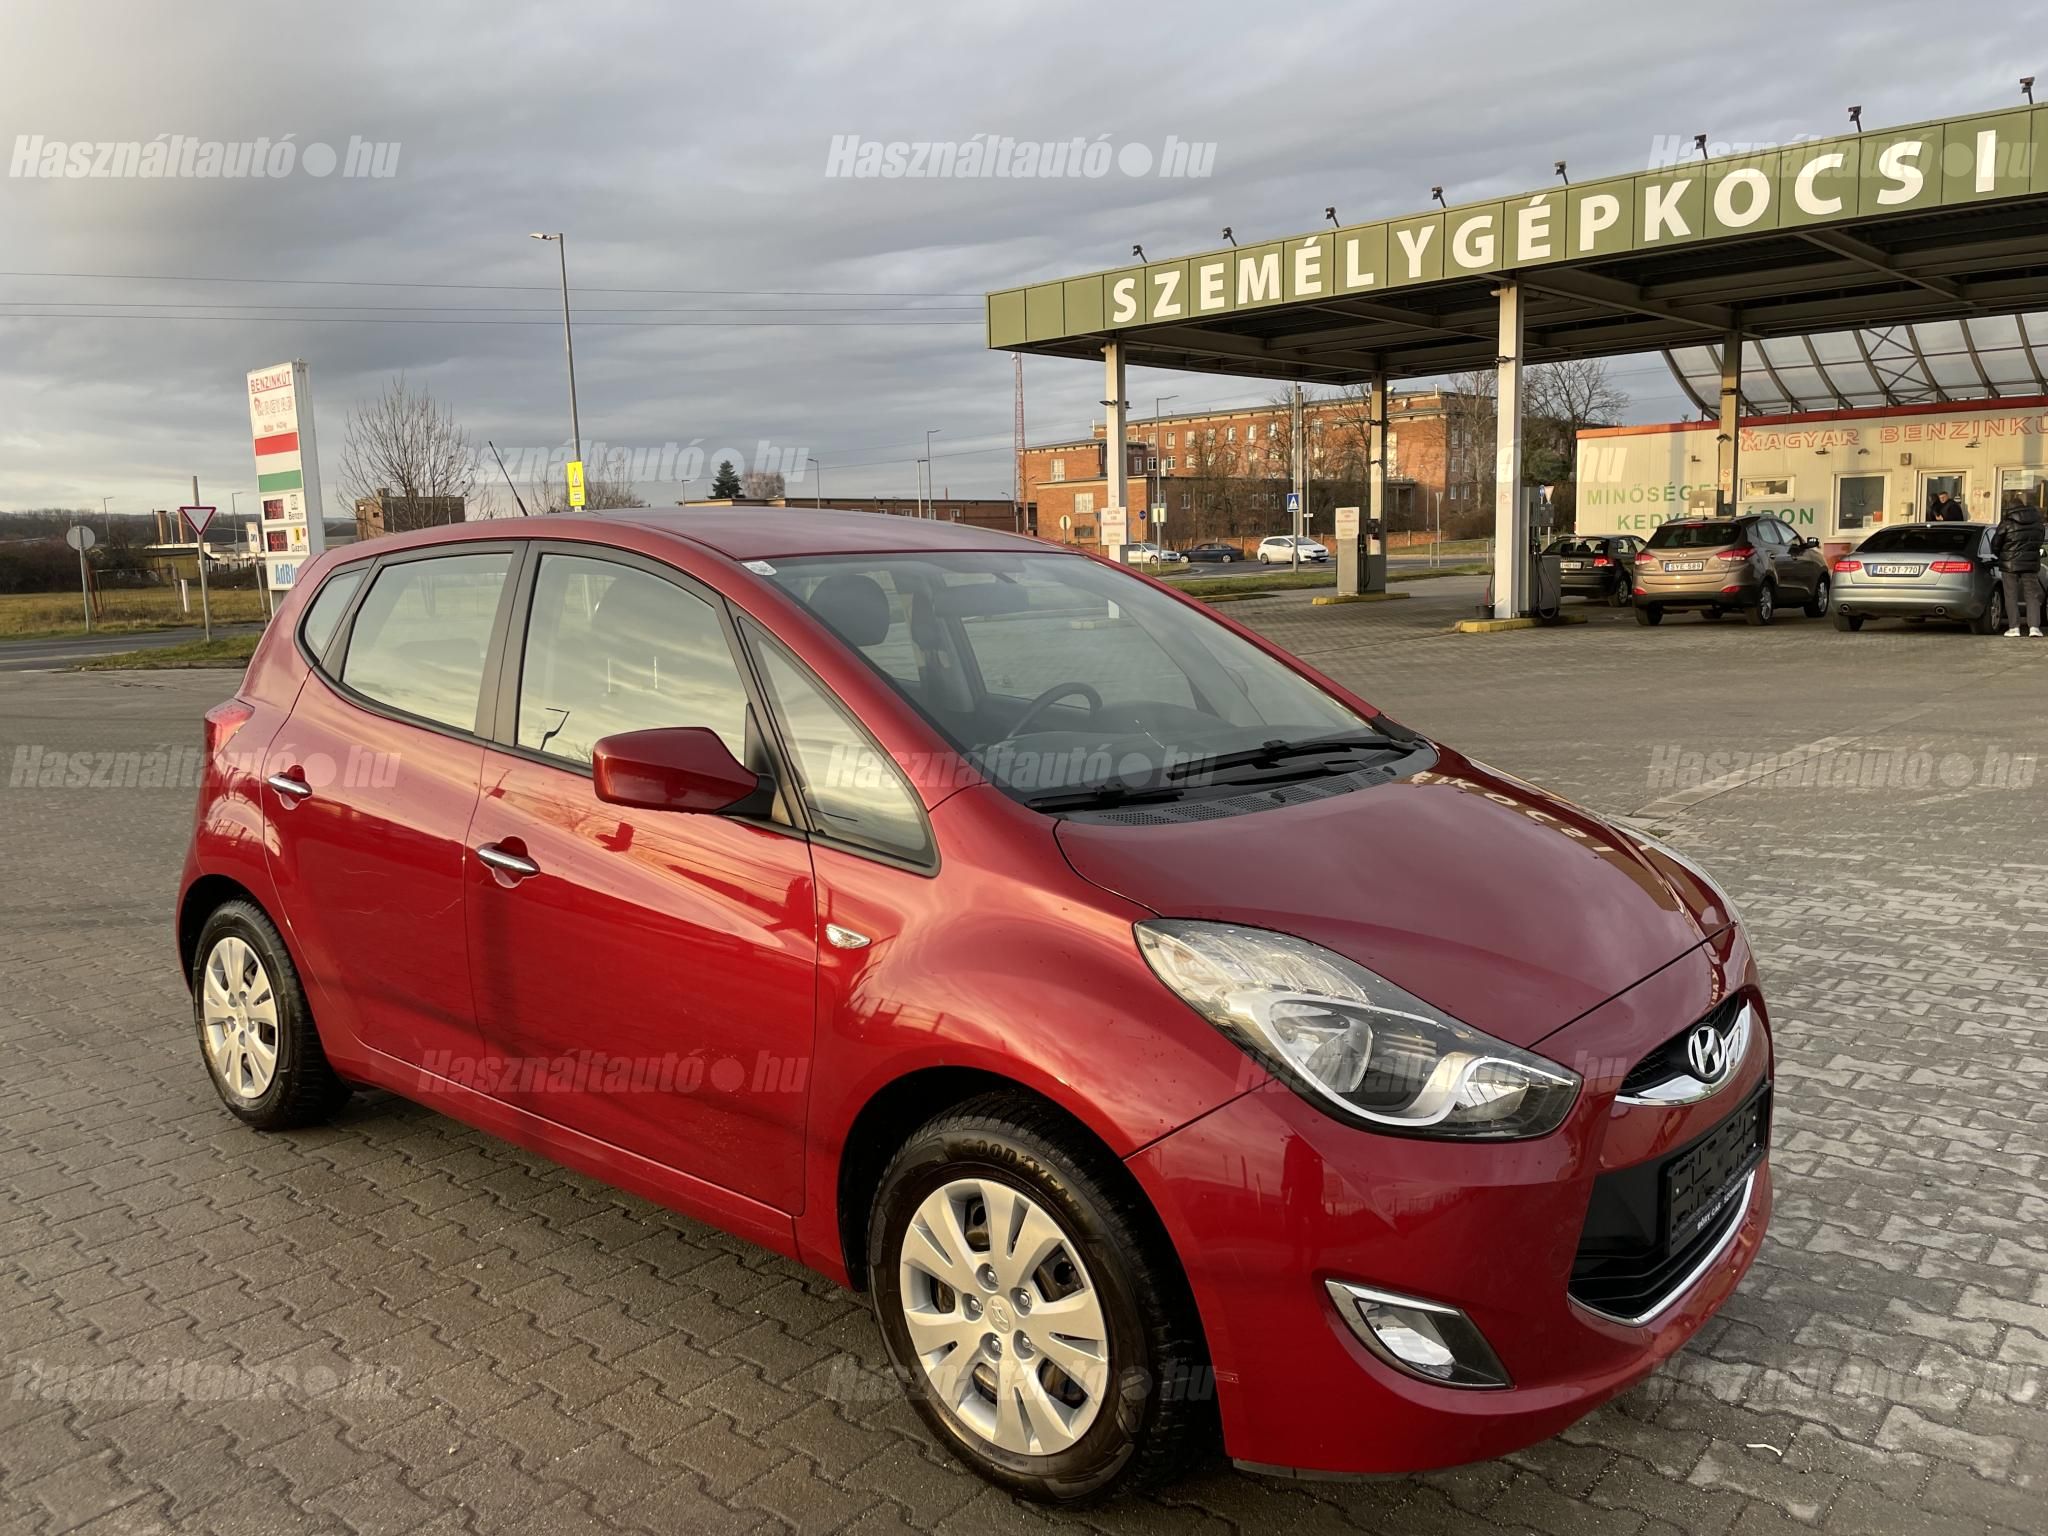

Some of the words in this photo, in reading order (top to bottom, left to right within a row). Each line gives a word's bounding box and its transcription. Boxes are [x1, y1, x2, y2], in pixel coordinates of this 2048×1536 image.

[1112, 129, 1996, 323] SZEMÉLYGÉPKOCSI
[1741, 428, 1860, 451] MAGYAR
[275, 563, 298, 585] AdBl
